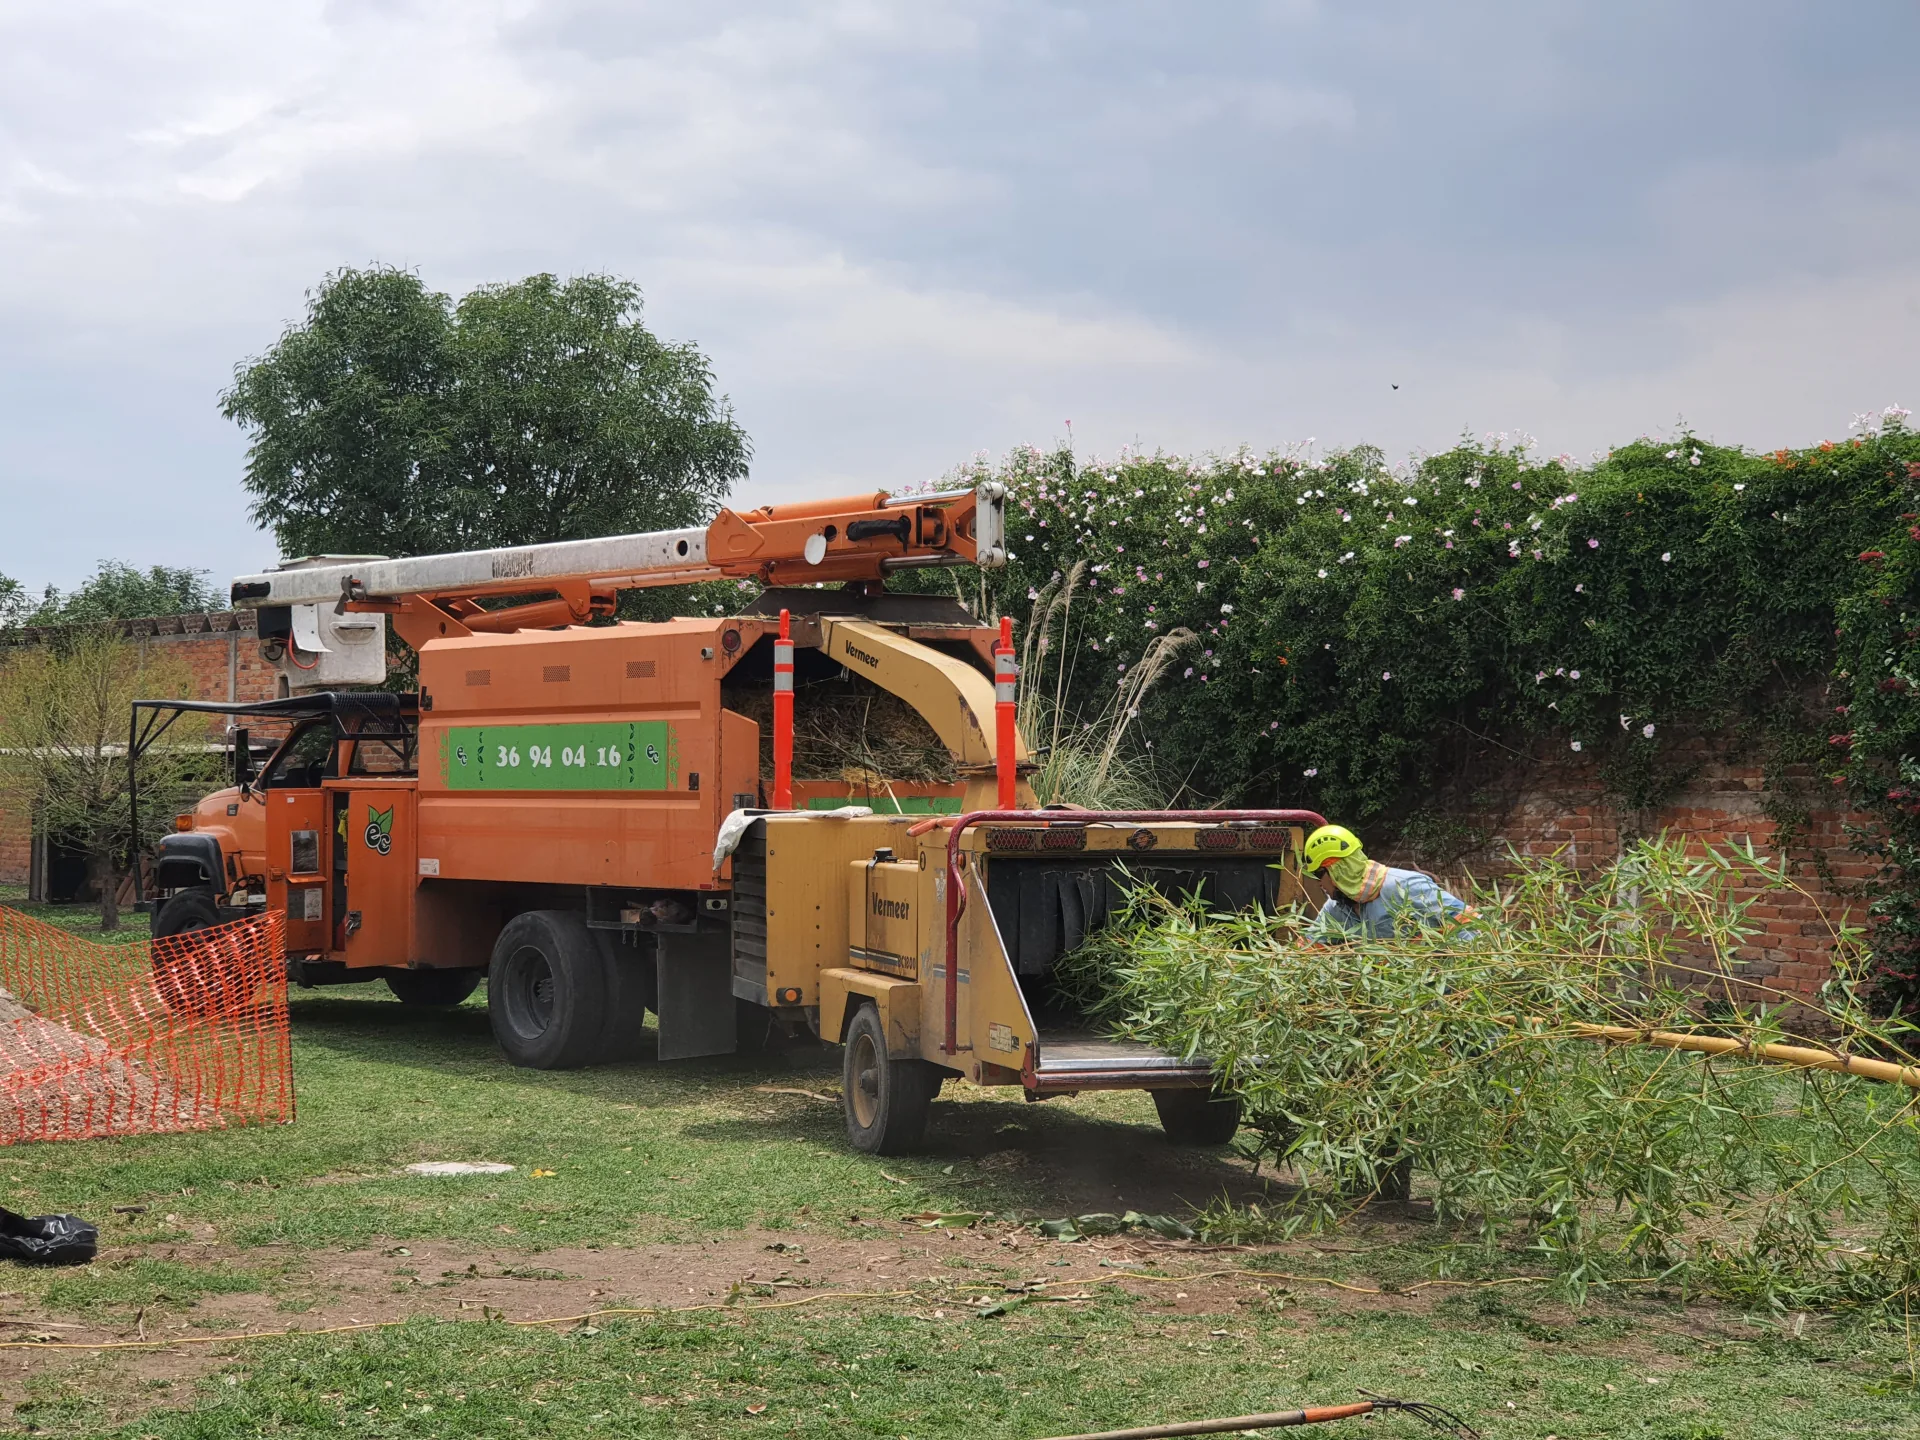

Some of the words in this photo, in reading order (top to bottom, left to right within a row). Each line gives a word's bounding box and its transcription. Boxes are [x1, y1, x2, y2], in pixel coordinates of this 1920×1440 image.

[845, 639, 879, 669] Vermeer
[496, 745, 520, 767] 36
[529, 745, 552, 768] 94
[561, 744, 586, 768] 04
[596, 744, 622, 767] 16
[871, 891, 910, 920] Vermeer
